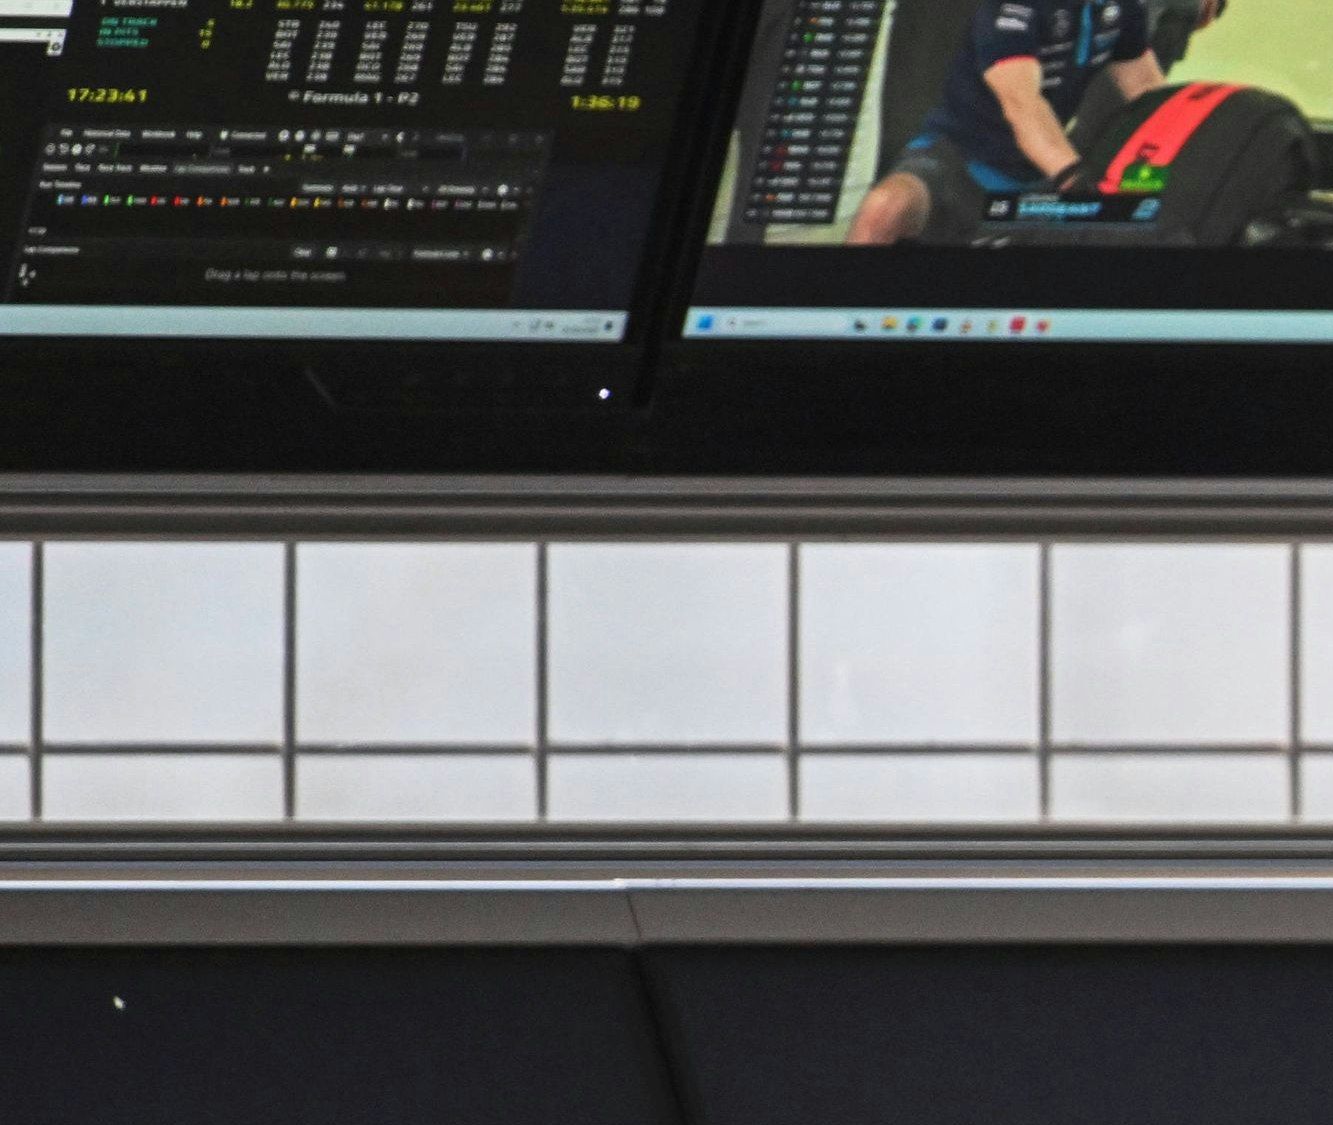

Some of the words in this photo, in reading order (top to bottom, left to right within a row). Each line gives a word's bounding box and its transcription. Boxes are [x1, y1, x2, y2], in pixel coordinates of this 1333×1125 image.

[67, 87, 148, 103] 17:23:41
[302, 90, 370, 105] Formula
[373, 91, 384, 104] 1
